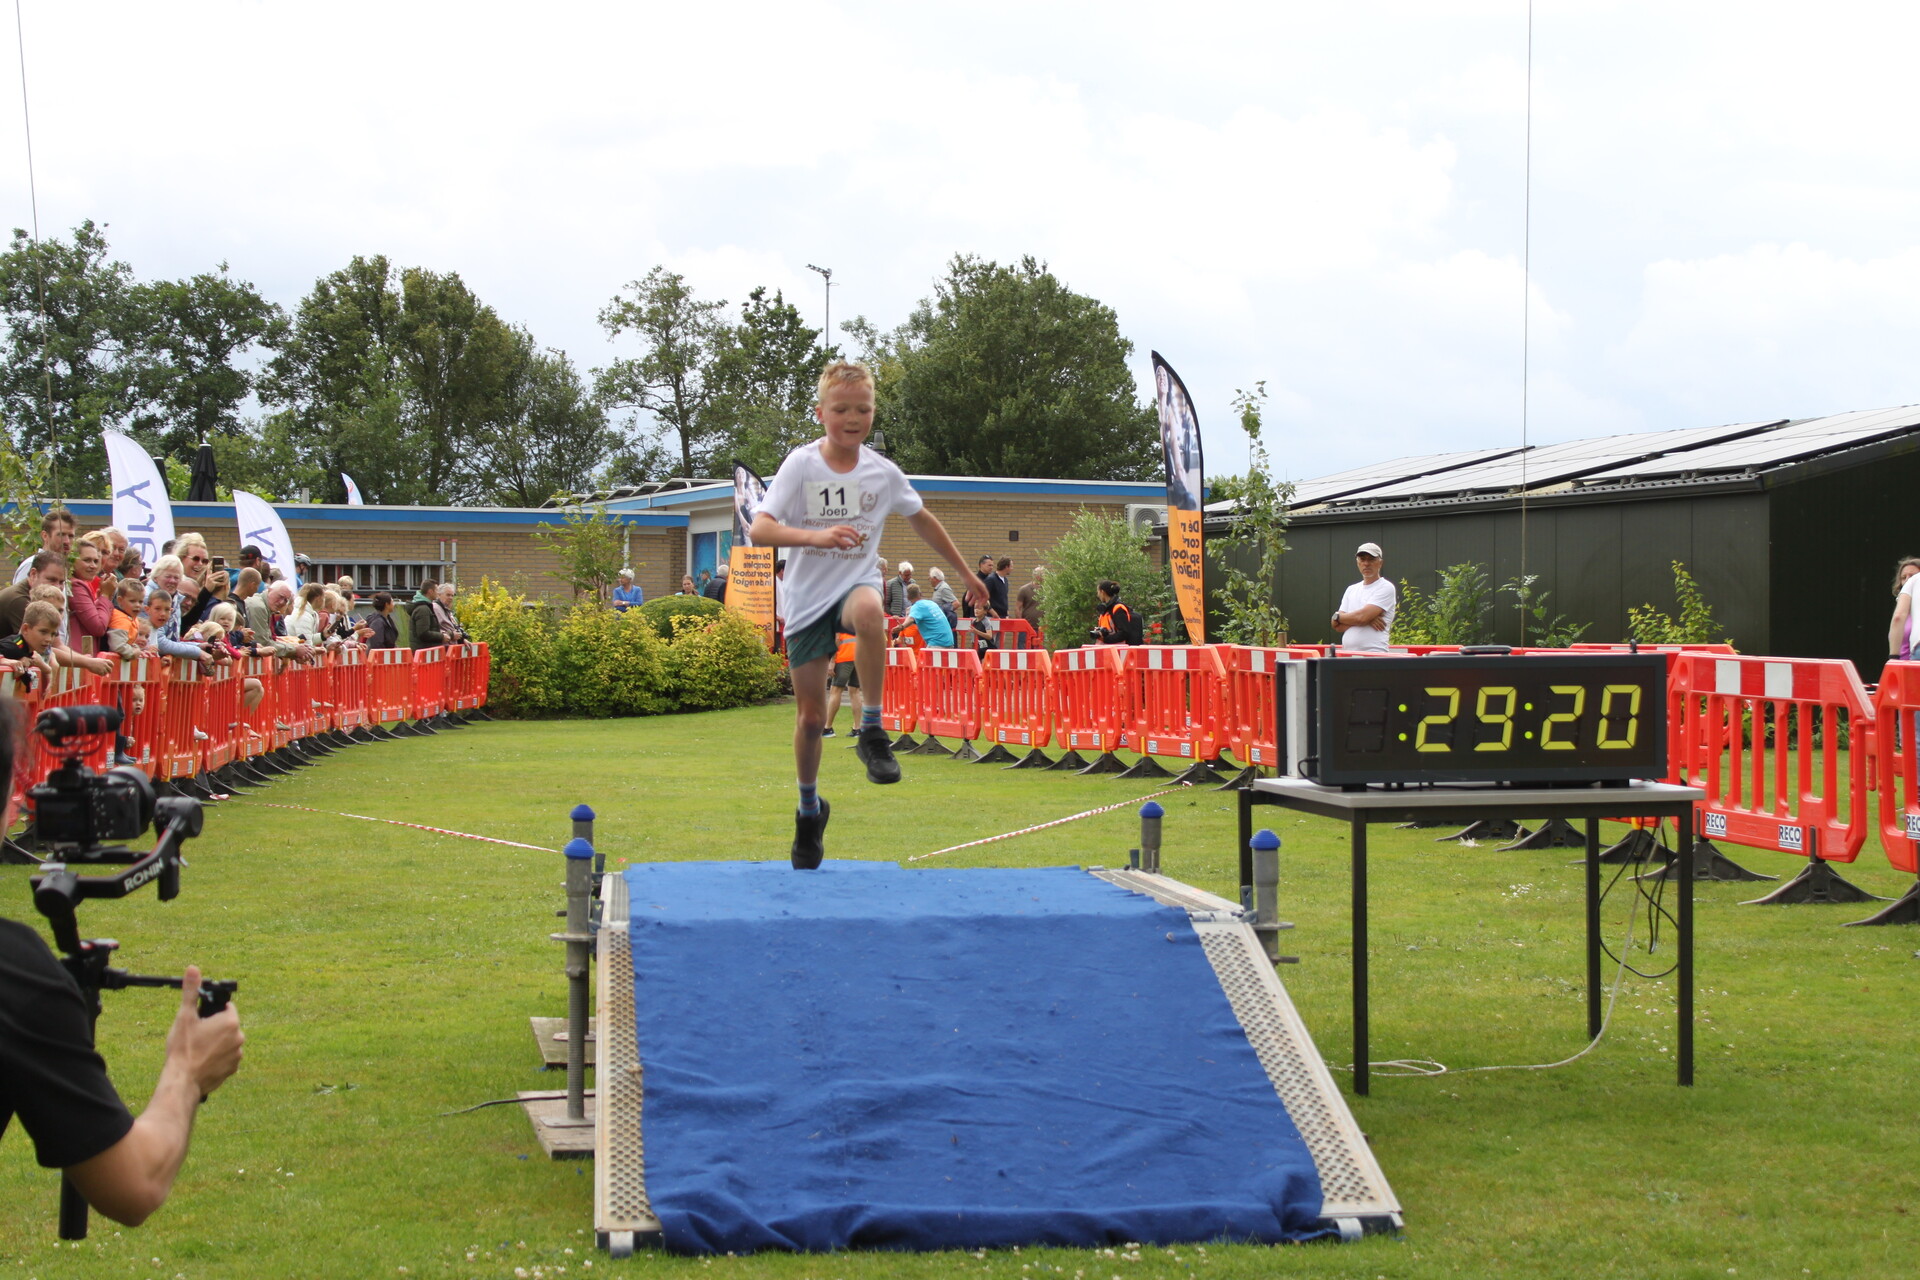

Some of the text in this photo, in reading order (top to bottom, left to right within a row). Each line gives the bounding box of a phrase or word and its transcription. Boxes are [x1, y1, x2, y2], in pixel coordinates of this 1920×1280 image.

[819, 487, 845, 506] 11
[820, 507, 848, 517] Joep
[801, 546, 868, 560] Junior Triathlon
[1706, 814, 1725, 829] RECO
[1779, 825, 1801, 842] RECO
[123, 857, 164, 892] RONIN
